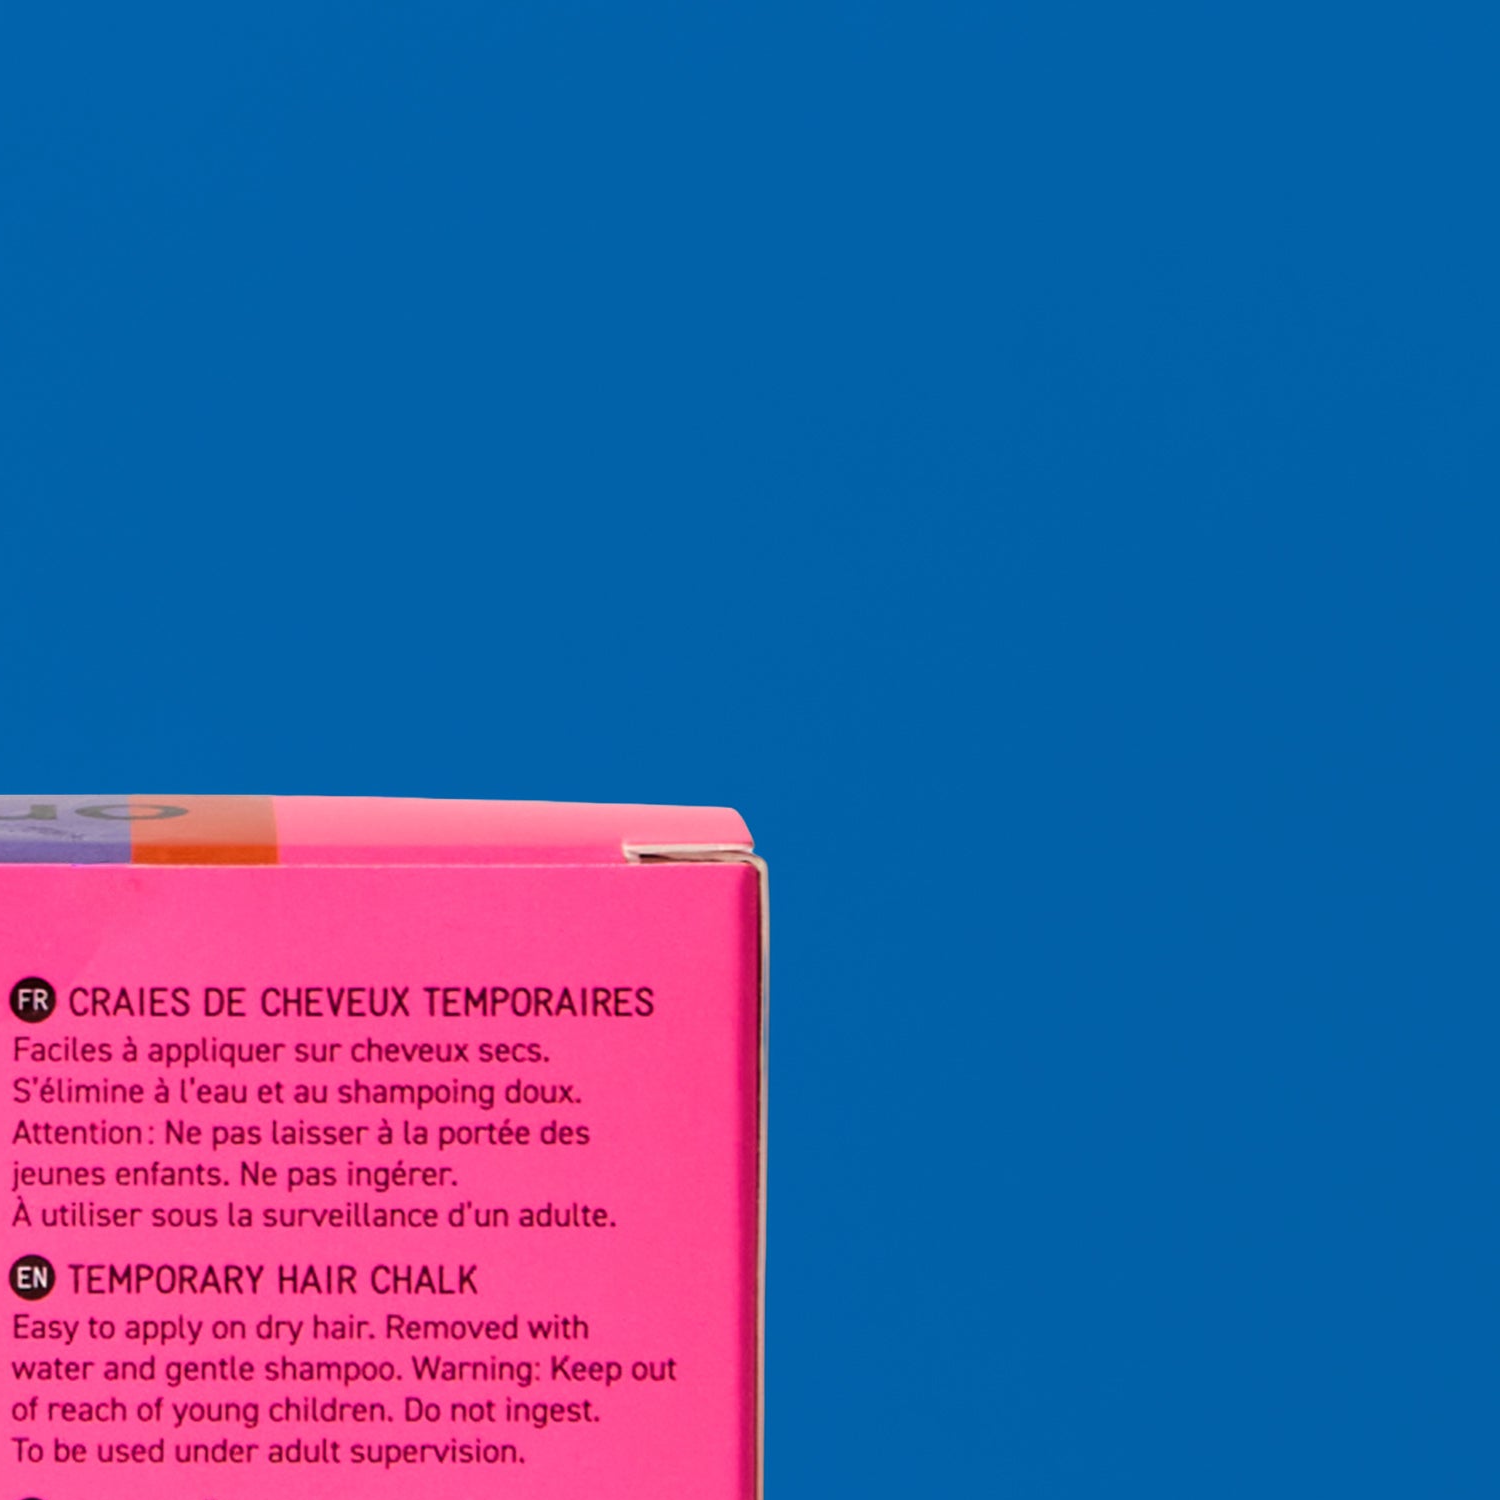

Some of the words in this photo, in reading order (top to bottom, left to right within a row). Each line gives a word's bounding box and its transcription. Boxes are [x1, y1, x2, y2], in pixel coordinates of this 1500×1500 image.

[17, 988, 49, 1012] FR
[68, 986, 191, 1018] CRAIES
[203, 986, 247, 1018] DE
[260, 986, 410, 1018] CHEVEUX
[422, 985, 655, 1018] TEMPORAIRES
[13, 1035, 113, 1063] Faciles
[122, 1035, 138, 1063] à
[147, 1036, 286, 1069] appliquer
[294, 1042, 342, 1063] sur
[350, 1036, 469, 1063] cheveux
[478, 1042, 550, 1063] secs.
[153, 1077, 170, 1104] à
[257, 1081, 284, 1105] et
[293, 1083, 328, 1105] au
[337, 1078, 495, 1111] shampoing
[504, 1078, 582, 1105] doux.
[165, 1119, 202, 1146] Ne
[212, 1125, 262, 1151] pas
[271, 1119, 370, 1146] laisser
[377, 1118, 394, 1146] à
[403, 1119, 429, 1146] la
[438, 1118, 531, 1151] portée
[539, 1119, 591, 1146] des
[11, 1160, 106, 1193] jeunes
[115, 1160, 230, 1187] enfants.
[240, 1160, 278, 1187] Ne
[287, 1166, 338, 1193] pas
[347, 1159, 458, 1194] ingérer.
[11, 1197, 33, 1228] À
[41, 1201, 143, 1228] utiliser
[151, 1207, 219, 1228] sous
[228, 1201, 253, 1228] la
[262, 1201, 439, 1228] surveillance
[518, 1201, 617, 1228] adulte.
[17, 1267, 49, 1291] EN
[67, 1263, 265, 1295] TEMPORARY
[277, 1263, 358, 1295] HAIR
[370, 1264, 478, 1295] CHALK
[13, 1313, 80, 1346] Easy
[87, 1316, 116, 1340] to
[124, 1314, 203, 1346] apply
[211, 1320, 247, 1340] on
[255, 1314, 304, 1346] dry
[312, 1314, 376, 1341] hair.
[386, 1313, 519, 1341] Removed
[527, 1313, 589, 1340] with
[11, 1357, 95, 1381] water
[103, 1354, 156, 1381] and
[165, 1355, 255, 1388] gentle
[264, 1355, 403, 1387] shampoo.
[411, 1355, 540, 1388] Warning:
[550, 1355, 623, 1387] Keep
[631, 1358, 677, 1382] out
[11, 1395, 39, 1422] of
[47, 1397, 127, 1423] reach
[136, 1397, 164, 1423] of
[172, 1402, 260, 1429] young
[268, 1396, 394, 1423] children.
[404, 1396, 441, 1423] Do
[450, 1400, 496, 1423] not
[505, 1397, 600, 1430] ingest.
[11, 1437, 44, 1463] To
[53, 1437, 88, 1464] be
[97, 1437, 165, 1464] used
[175, 1438, 259, 1464] under
[267, 1437, 341, 1464] adult
[350, 1438, 525, 1470] supervision.
